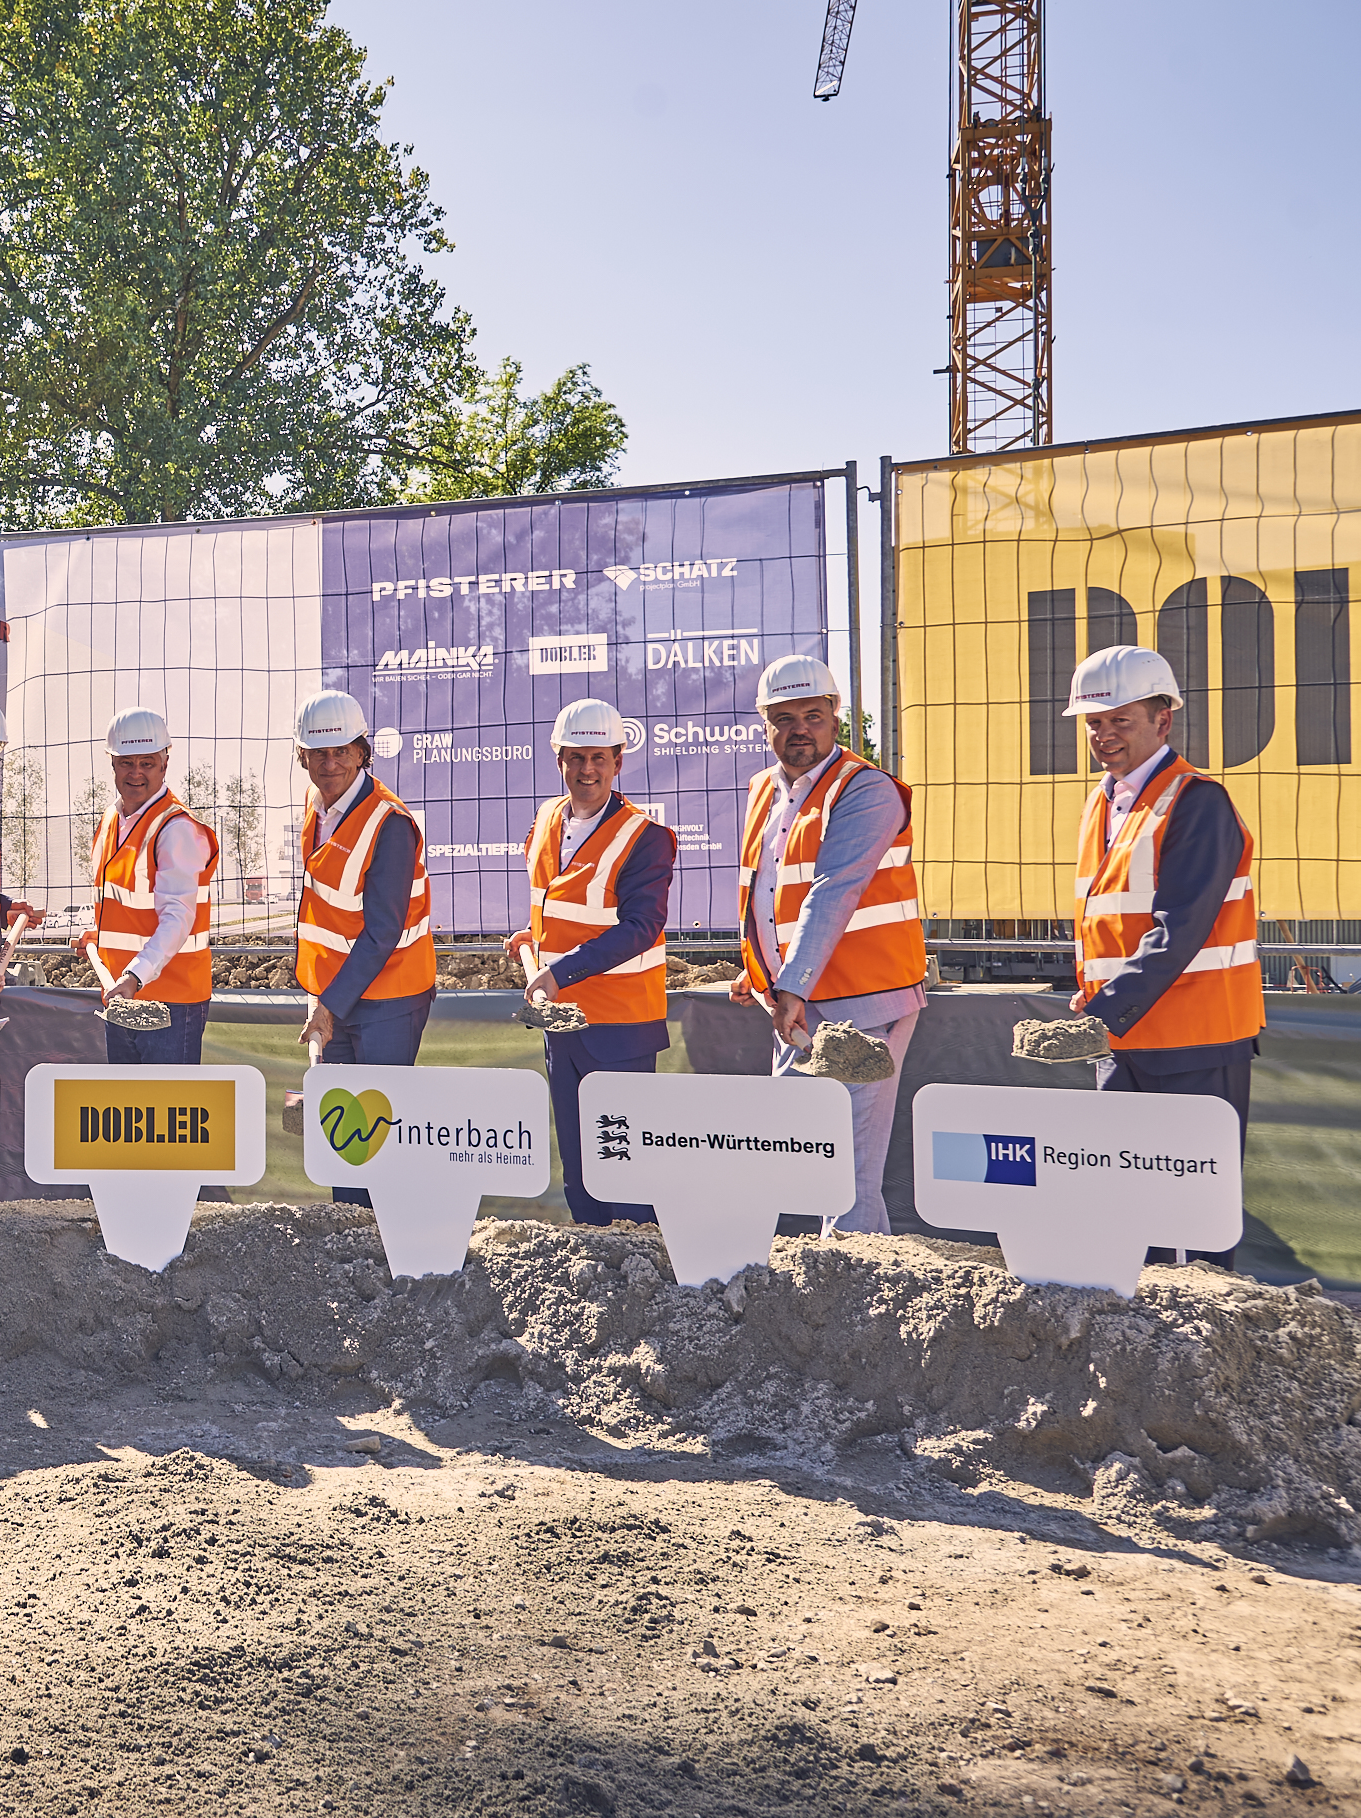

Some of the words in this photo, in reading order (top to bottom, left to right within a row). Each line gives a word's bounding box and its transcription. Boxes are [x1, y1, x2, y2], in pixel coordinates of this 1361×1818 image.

[639, 558, 737, 582] SCHATZ
[372, 569, 576, 602] PFISTERER
[677, 580, 700, 588] GmbH
[540, 645, 596, 663] DOBLER
[772, 682, 811, 693] PFISTERER
[413, 733, 453, 749] GRAW
[653, 745, 719, 756] SHIELDING
[724, 743, 772, 754] SYSTEM
[413, 744, 532, 764] PLANUNGSBÜRO
[427, 842, 525, 858] SPEZIALTIEFBA
[79, 1106, 210, 1144] DOBLER
[641, 1131, 836, 1159] Baden-Württemberg
[449, 1151, 475, 1164] mehr
[478, 1152, 493, 1164] als
[495, 1152, 535, 1166] Heimat.
[990, 1142, 1033, 1164] IHK
[1043, 1146, 1112, 1171] Region
[1118, 1150, 1218, 1177] Stuttgart
